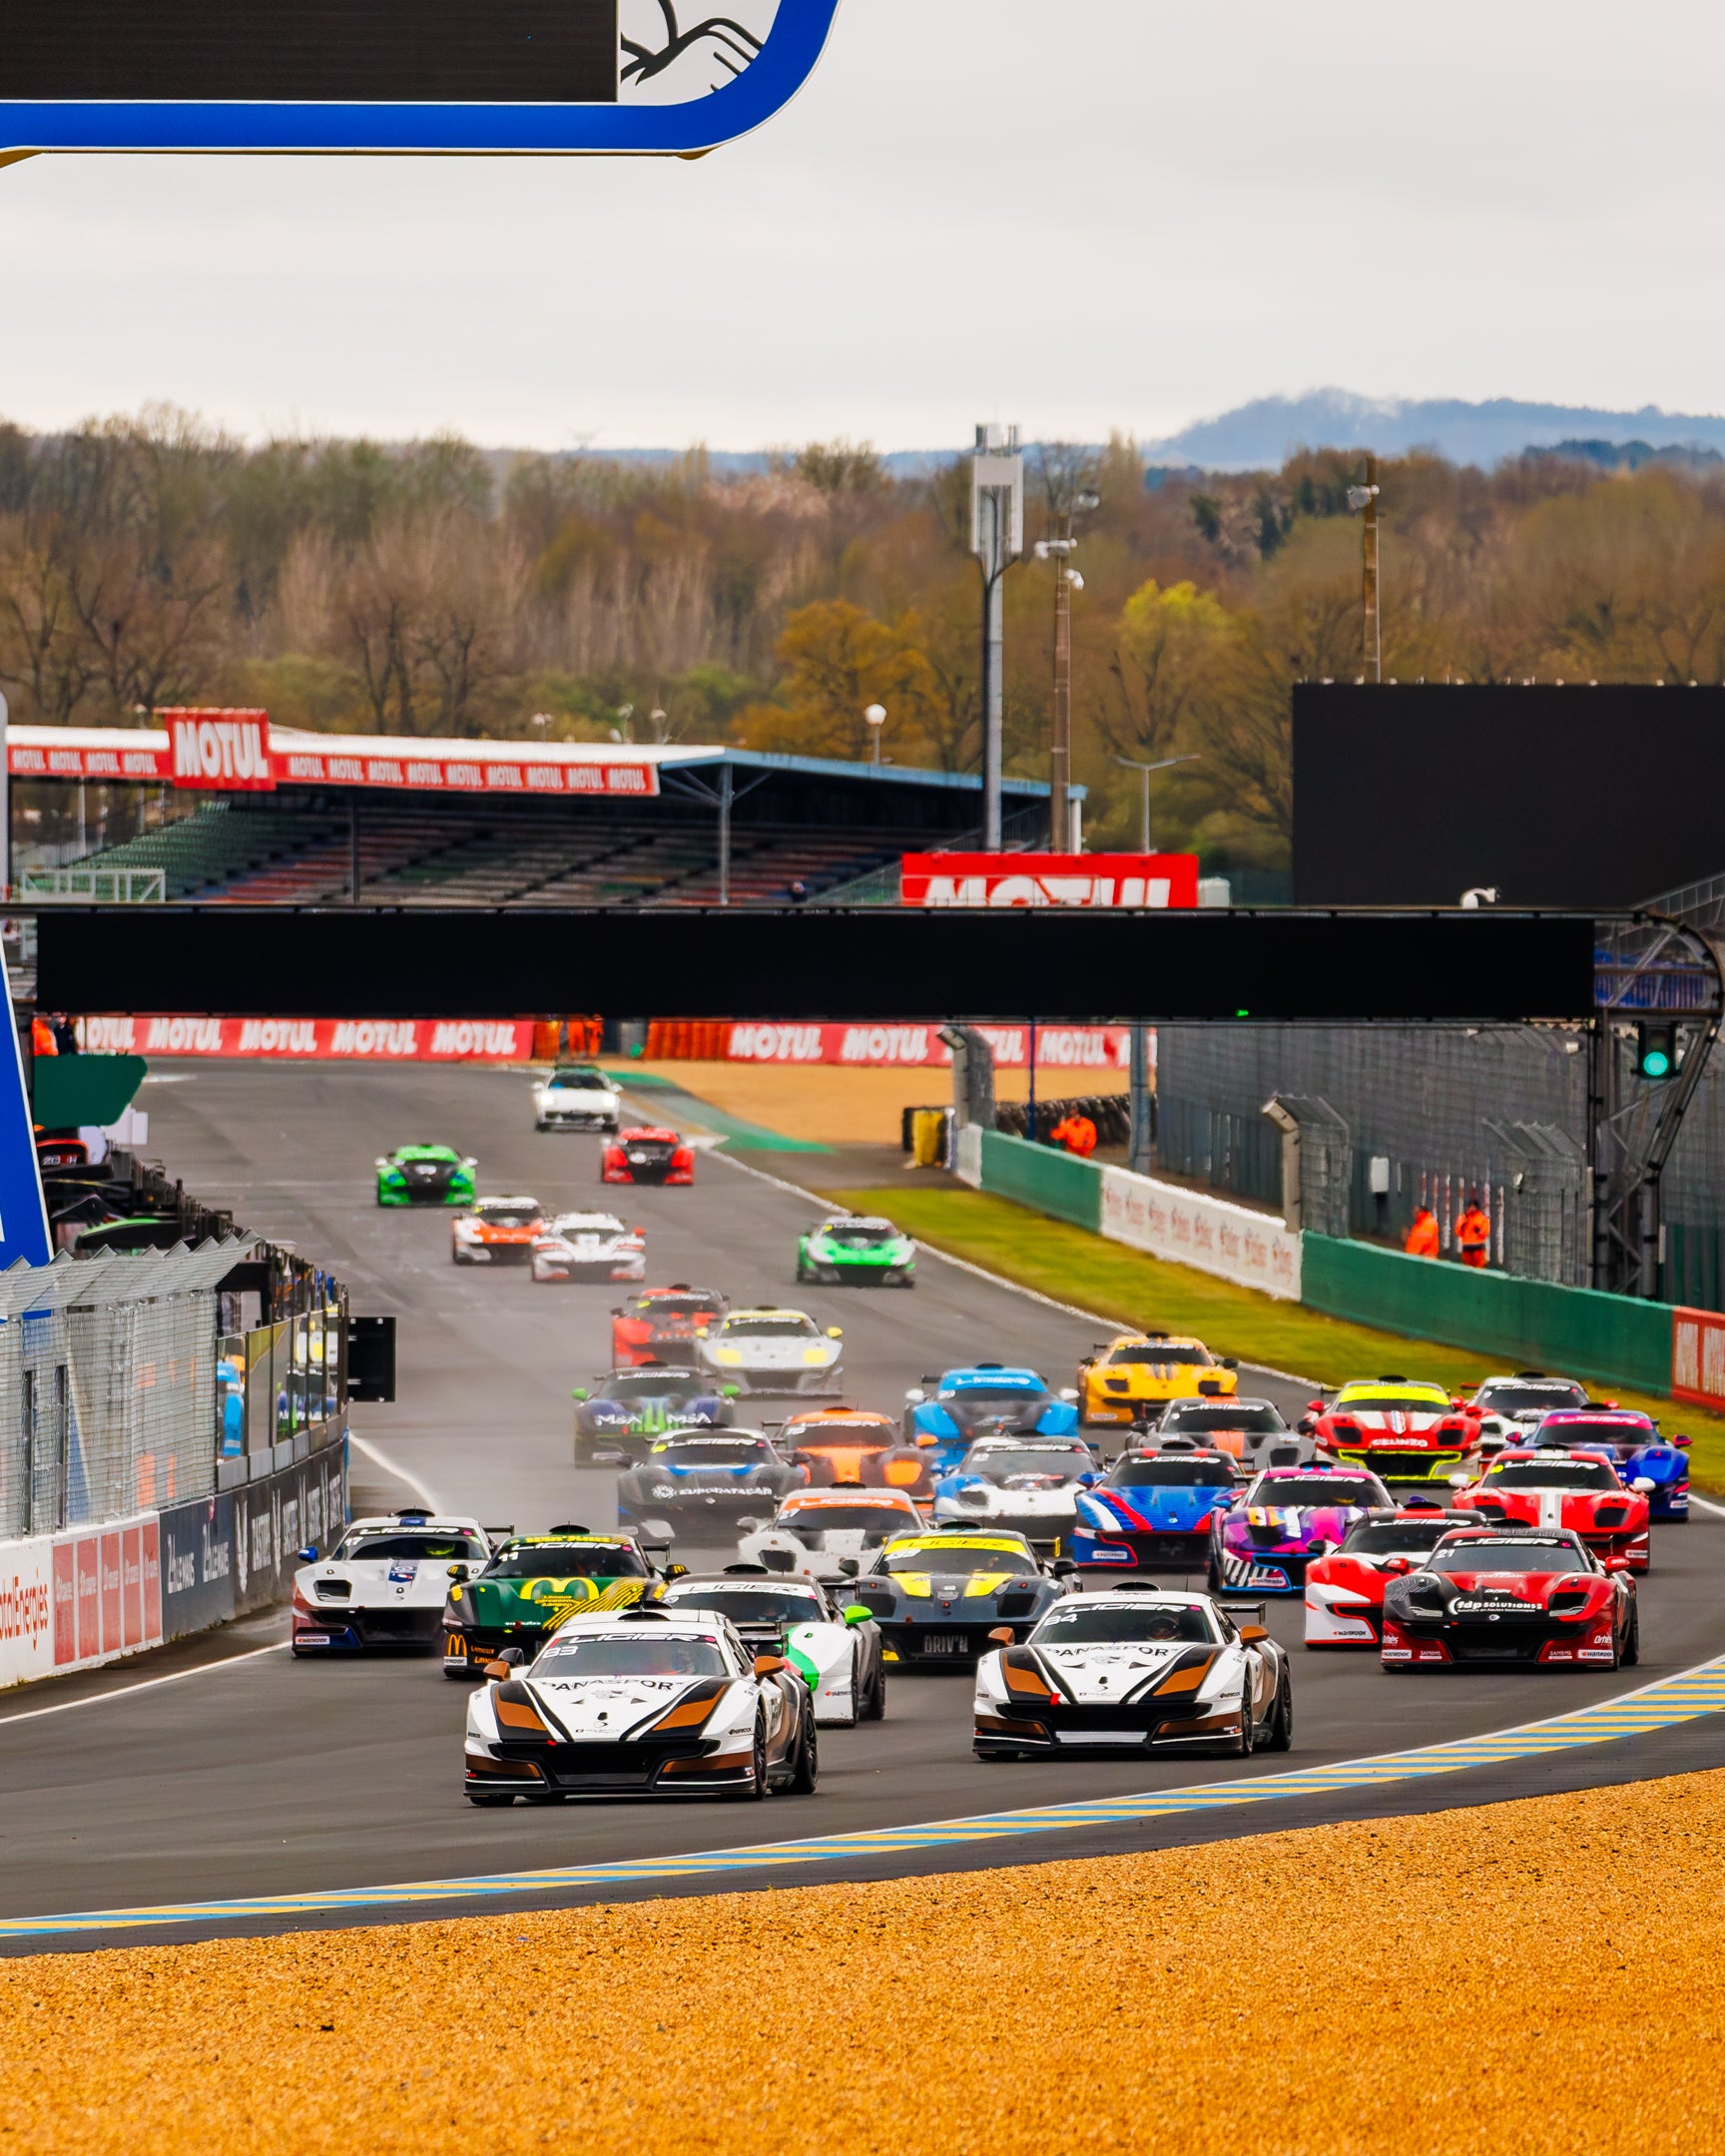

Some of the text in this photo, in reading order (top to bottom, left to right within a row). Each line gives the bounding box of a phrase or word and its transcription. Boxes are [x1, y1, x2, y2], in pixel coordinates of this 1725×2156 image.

[175, 721, 270, 779] MOTUL
[12, 750, 158, 774] MOTUL MOTUL MOTUL MOTUL
[288, 756, 646, 791] MOTUL MOTUL MOTUL MOTUL MOTUL MOTUL MOTUL MOTUL MOTUL
[148, 1017, 223, 1050] MOTUL
[239, 1019, 316, 1052] MOTUL
[330, 1020, 418, 1055] MOTUL
[430, 1022, 517, 1055] MOTUL
[729, 1025, 823, 1060] MOTUL
[842, 1027, 928, 1060] MOTUL
[1037, 1031, 1107, 1064] MOTUL
[511, 1541, 622, 1551] LIGIER
[1452, 1537, 1559, 1547] LIGIER
[498, 1551, 519, 1562] 11
[1436, 1548, 1455, 1559] 21
[1065, 1602, 1188, 1613] LIGIER
[1044, 1613, 1078, 1627] 84
[568, 1633, 700, 1644] LIGIER
[541, 1645, 579, 1659] 83
